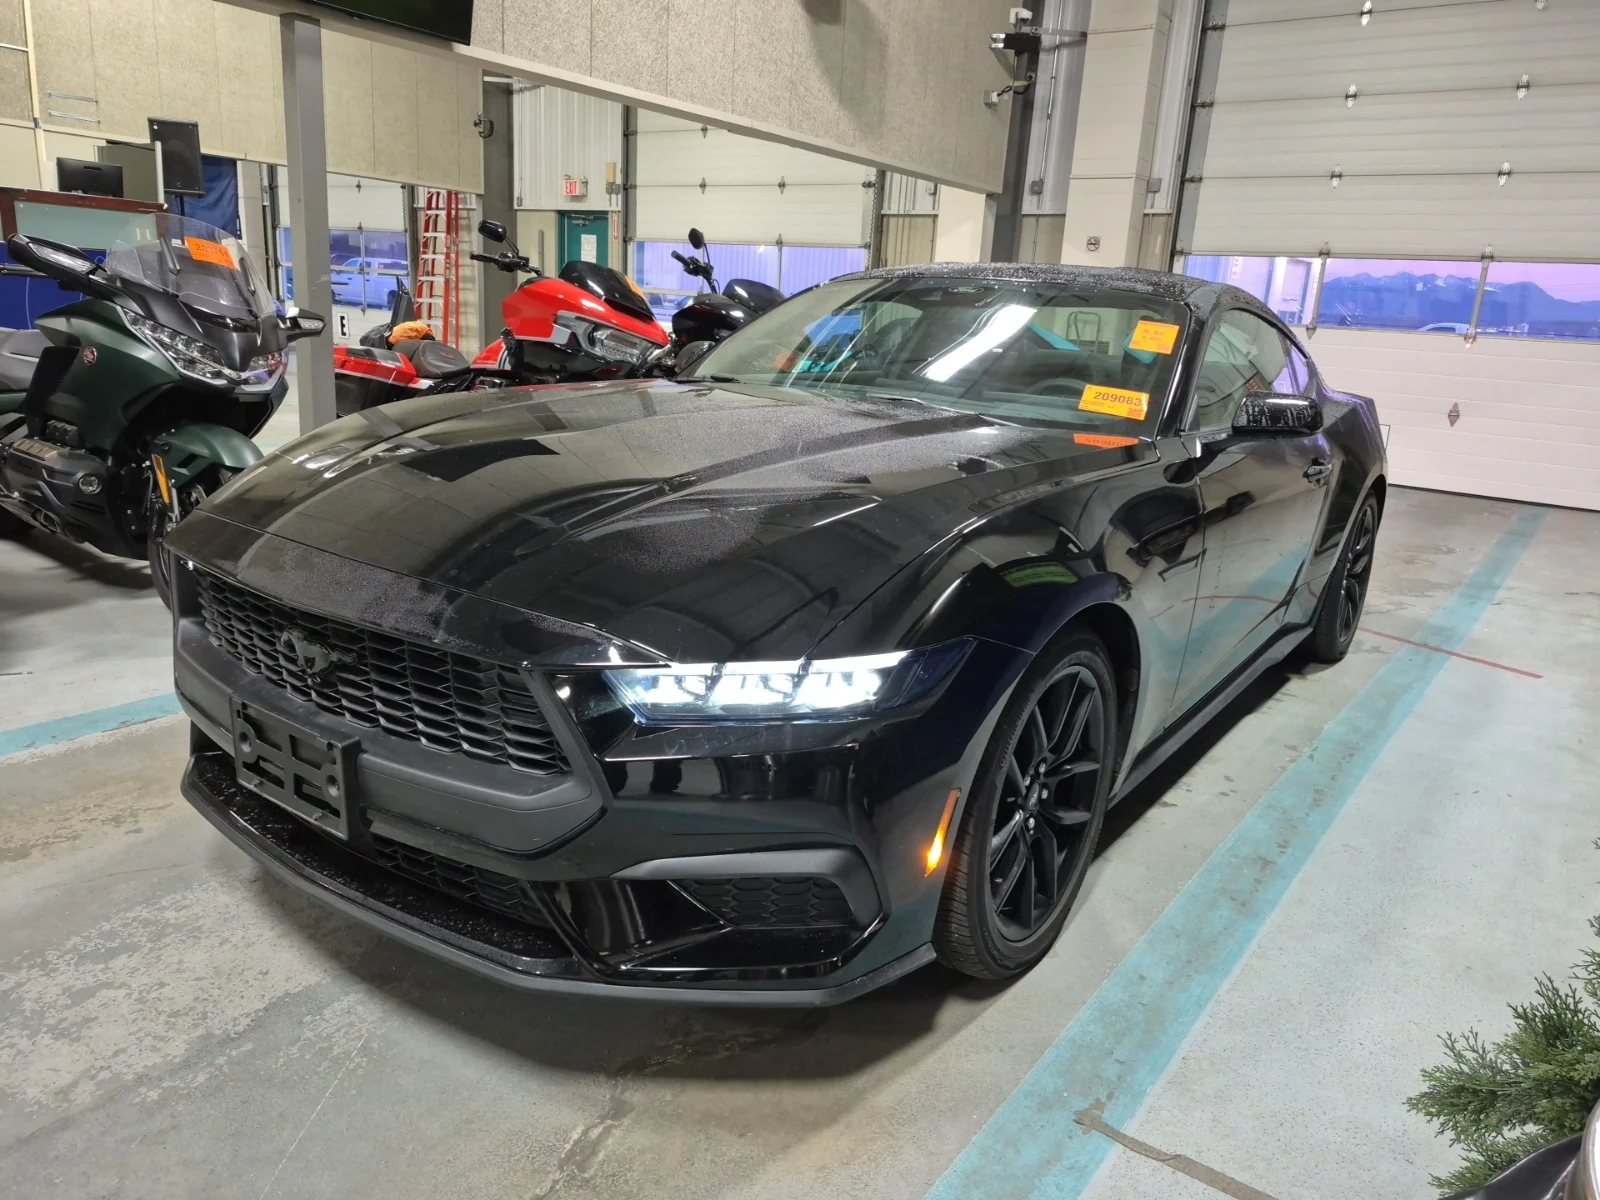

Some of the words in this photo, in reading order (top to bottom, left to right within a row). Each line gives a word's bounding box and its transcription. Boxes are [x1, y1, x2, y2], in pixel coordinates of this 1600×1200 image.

[565, 181, 577, 194] EXIT
[339, 315, 347, 337] E
[1093, 391, 1143, 406] 209083
